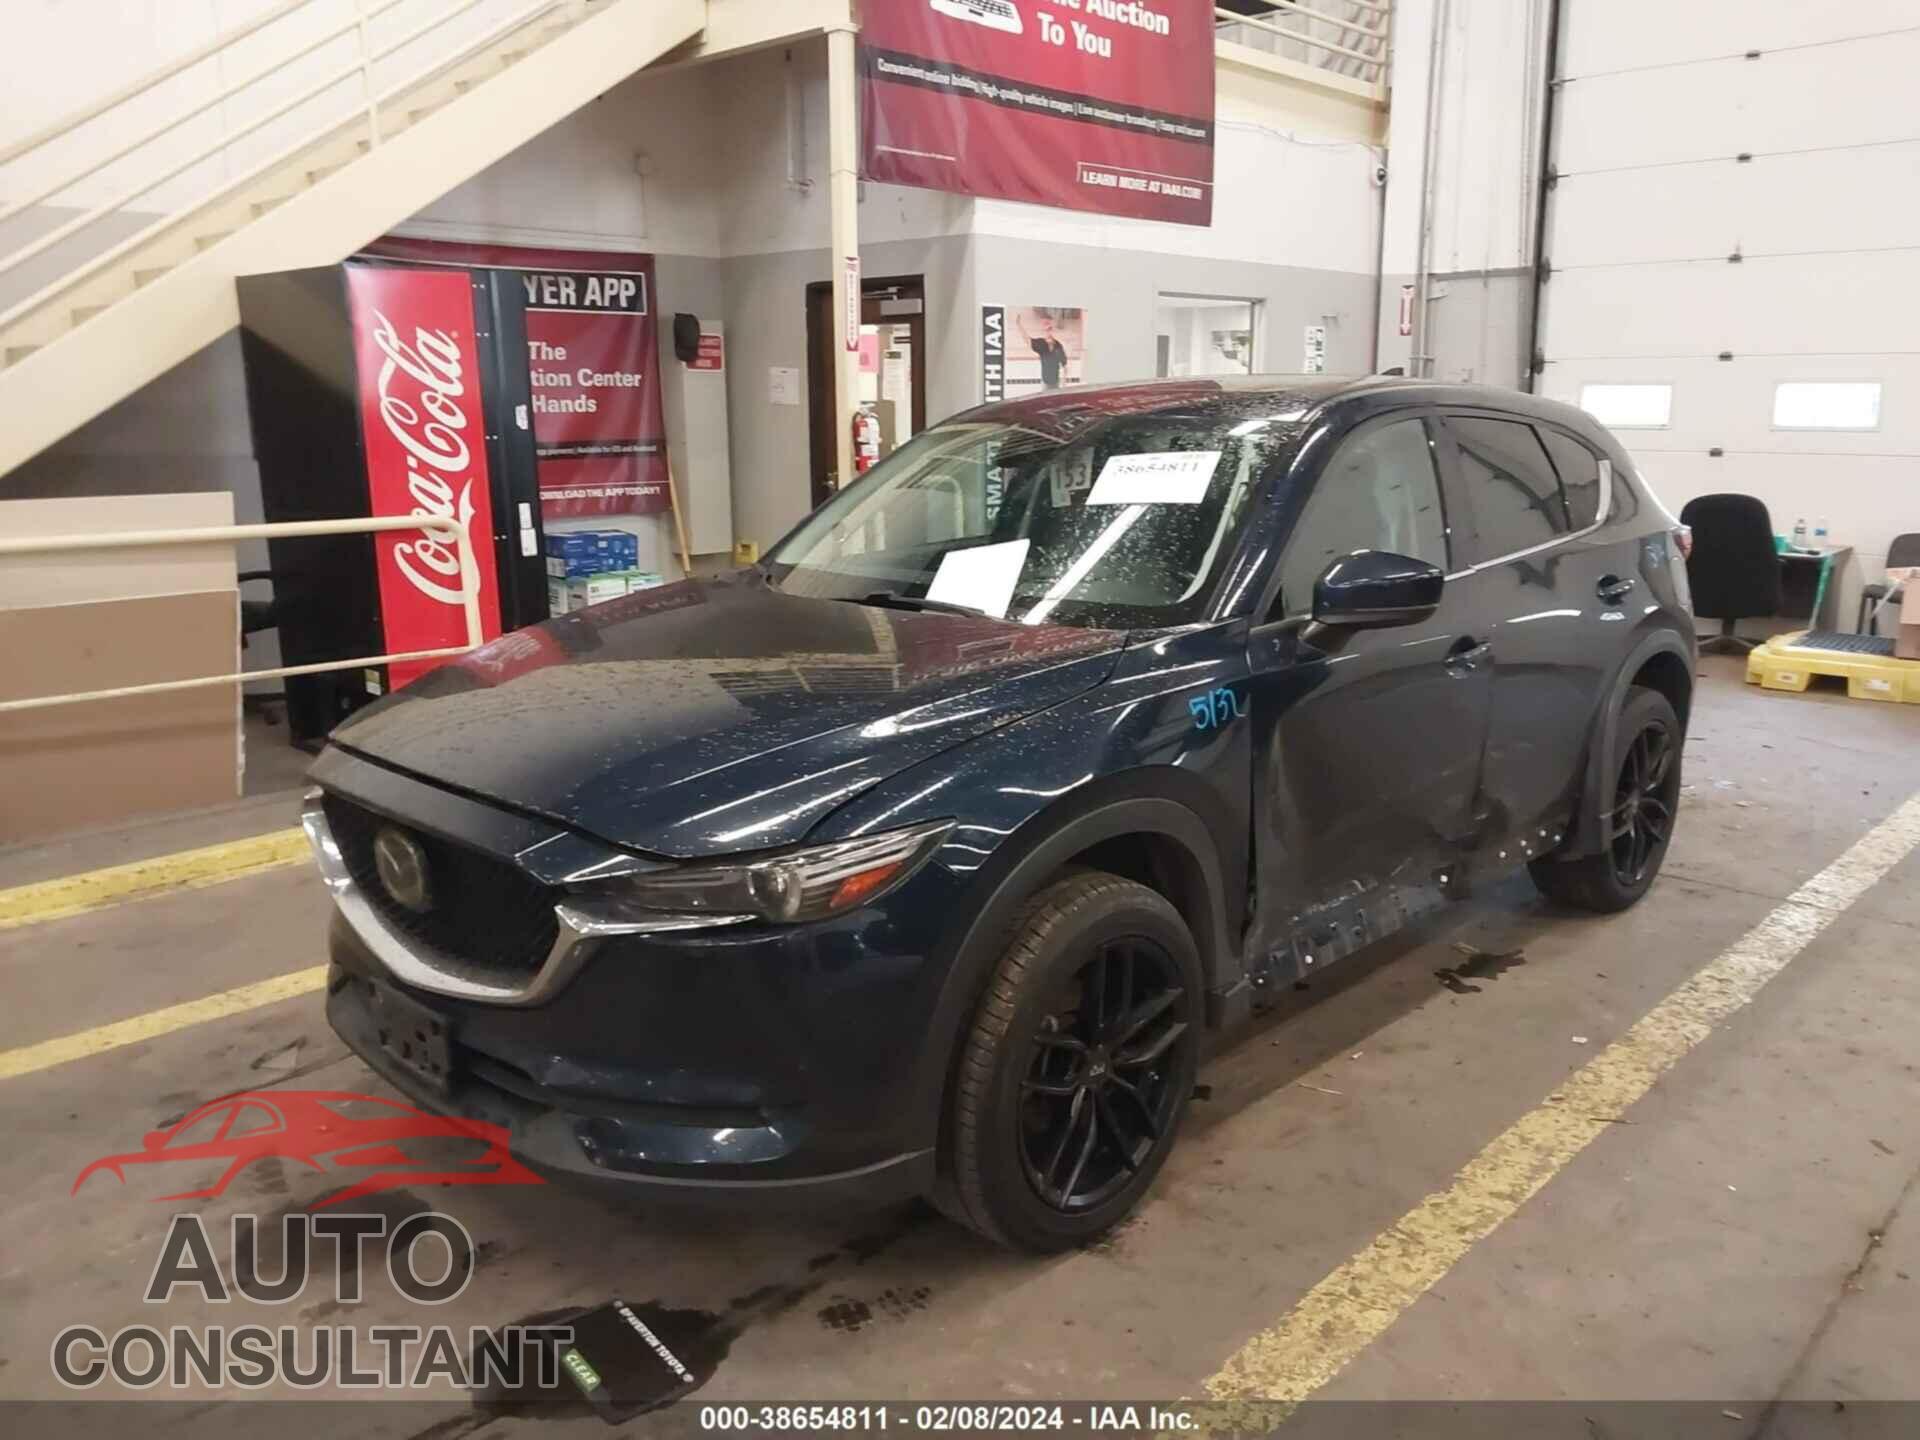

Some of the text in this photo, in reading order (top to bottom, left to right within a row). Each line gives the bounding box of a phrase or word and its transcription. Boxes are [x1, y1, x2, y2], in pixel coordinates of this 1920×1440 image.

[1085, 0, 1170, 35] Auction
[1037, 11, 1112, 58] To You
[1082, 170, 1118, 188] LEARN
[1118, 175, 1148, 192] MORE
[522, 274, 636, 308] YER APP
[985, 312, 1002, 355] IAA
[528, 341, 567, 361] The
[530, 368, 642, 388] tion Center
[531, 394, 598, 413] Hands
[605, 487, 625, 497] APP
[565, 1353, 598, 1386] CLEAR
[655, 1344, 687, 1376] TOYOTA
